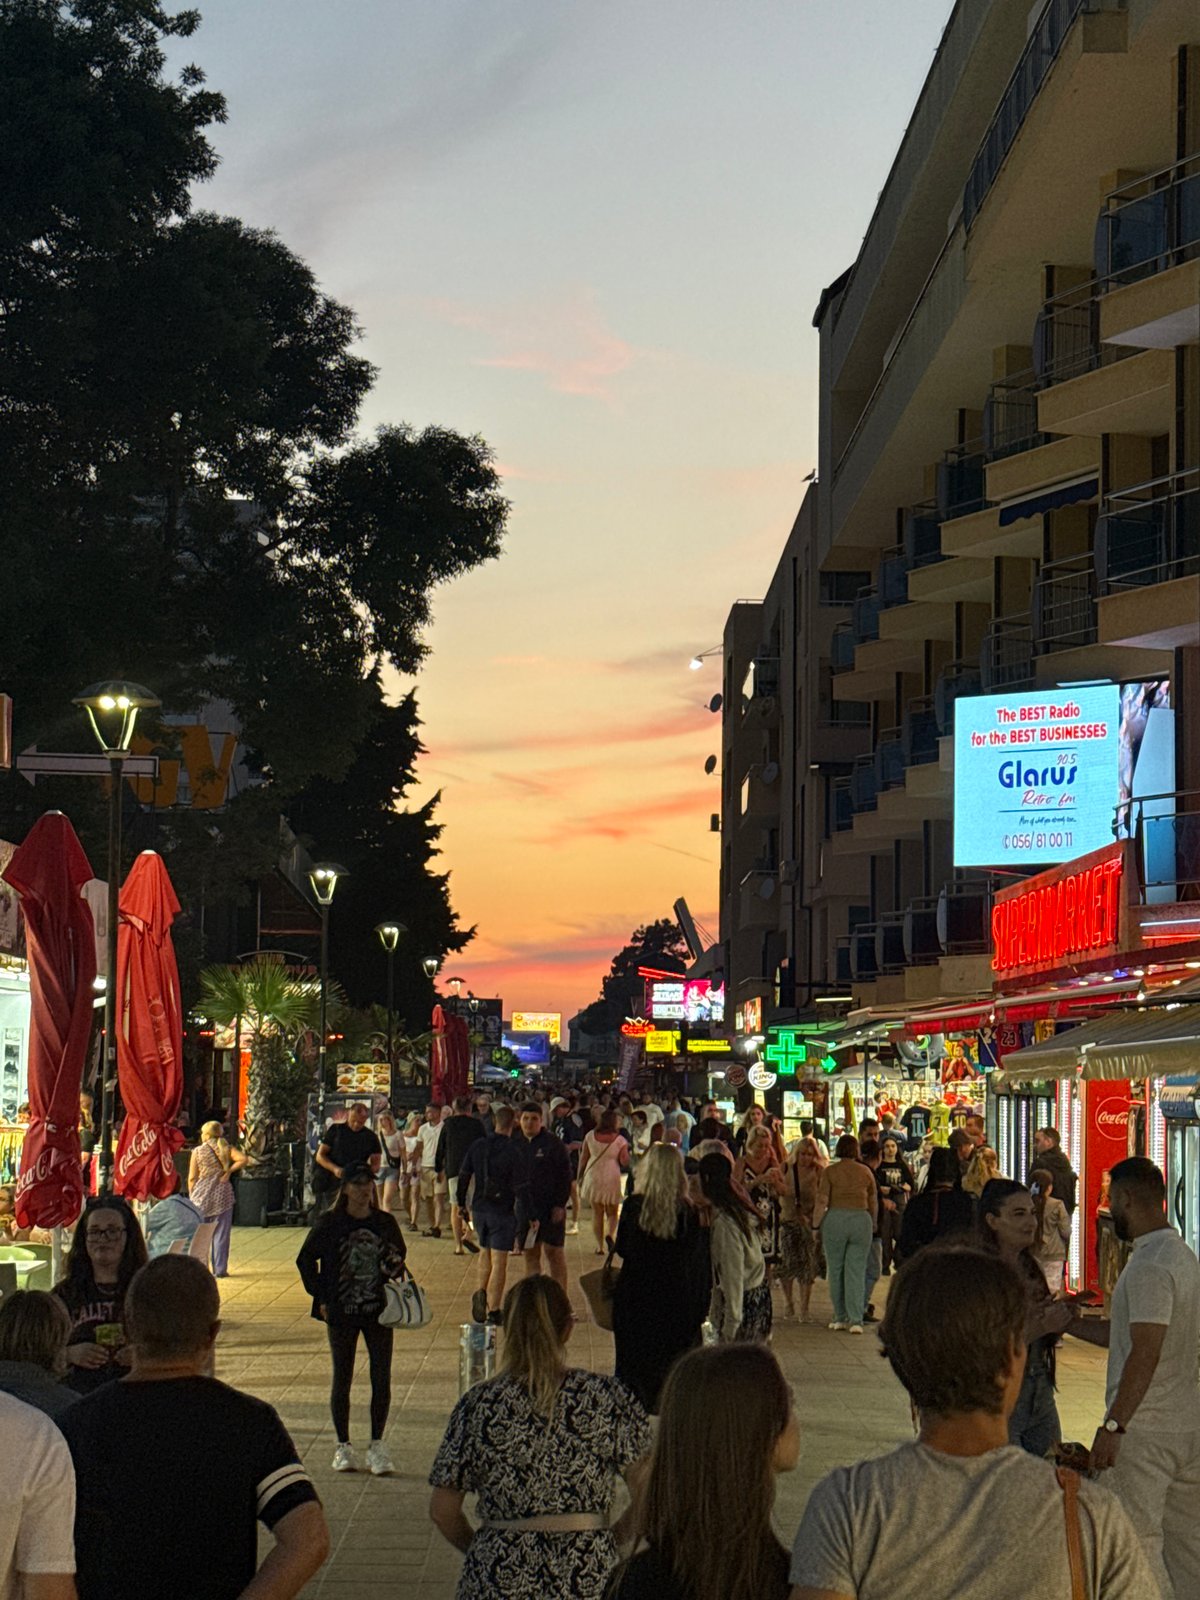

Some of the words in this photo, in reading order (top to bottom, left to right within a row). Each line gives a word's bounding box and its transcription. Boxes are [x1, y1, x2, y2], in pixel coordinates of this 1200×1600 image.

[997, 707, 1017, 723] The
[1019, 706, 1047, 721] BEST
[1049, 702, 1081, 719] Radio
[971, 731, 987, 747] for
[989, 730, 1007, 745] the
[1010, 728, 1037, 744] BEST
[1039, 723, 1107, 742] BUSINESSES
[998, 760, 1078, 788] Glarus
[1021, 789, 1056, 807] Retro
[1036, 833, 1047, 848] 81
[1049, 832, 1063, 848] 00
[1064, 832, 1073, 847] 11
[991, 857, 1122, 970] SUPERMARKET
[1002, 1030, 1016, 1047] 23
[954, 1115, 967, 1128] 10
[1097, 1110, 1129, 1126] Coca-Co
[910, 1118, 927, 1138] 10
